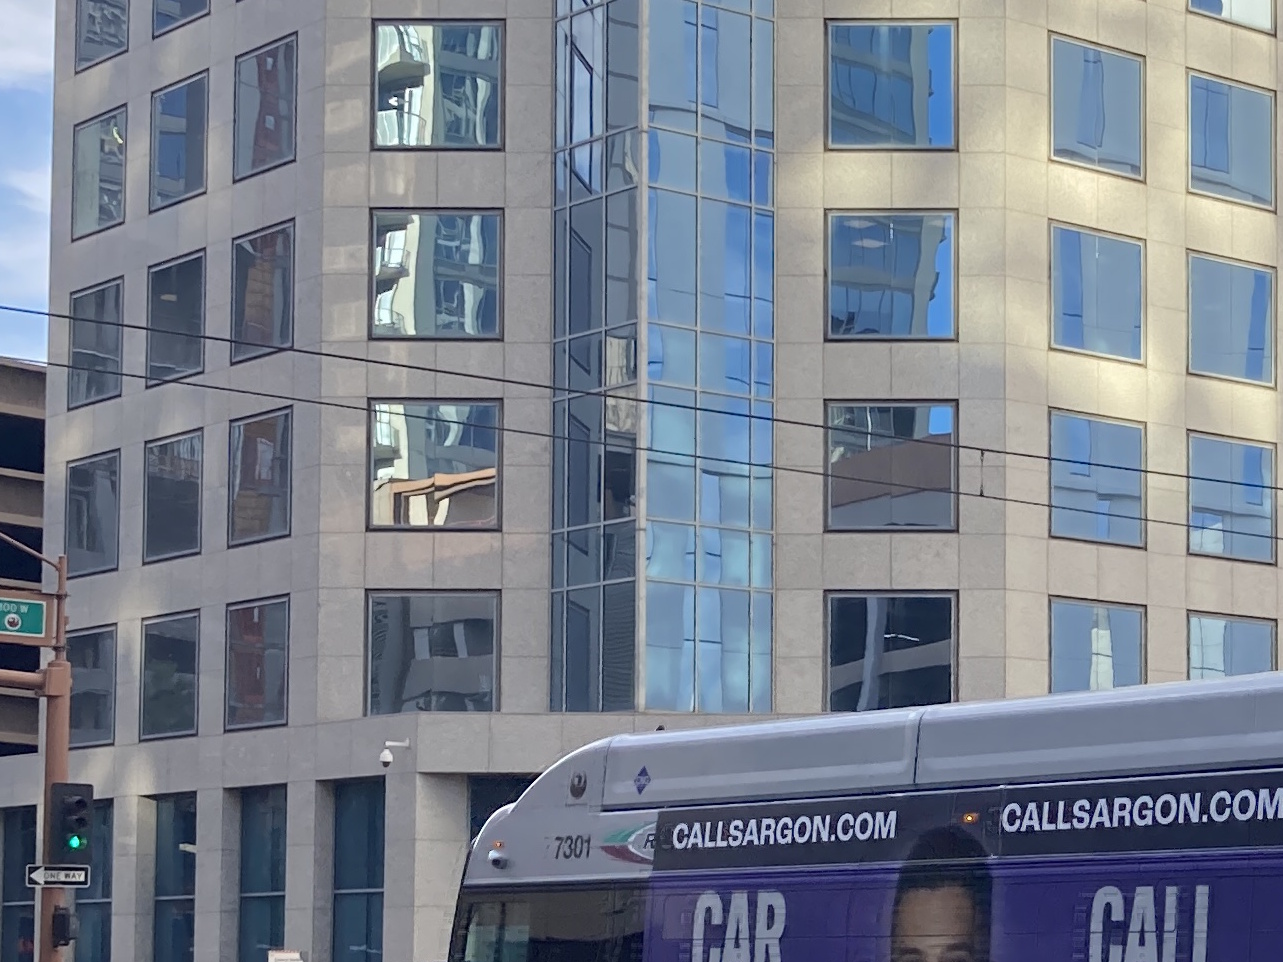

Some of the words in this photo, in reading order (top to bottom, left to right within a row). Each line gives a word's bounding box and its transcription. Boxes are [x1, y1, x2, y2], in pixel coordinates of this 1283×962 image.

[20, 605, 29, 613] W
[672, 811, 897, 850] CALLSARGON.COM
[554, 835, 591, 860] 7301
[44, 872, 61, 880] ONE
[64, 872, 82, 880] WAY
